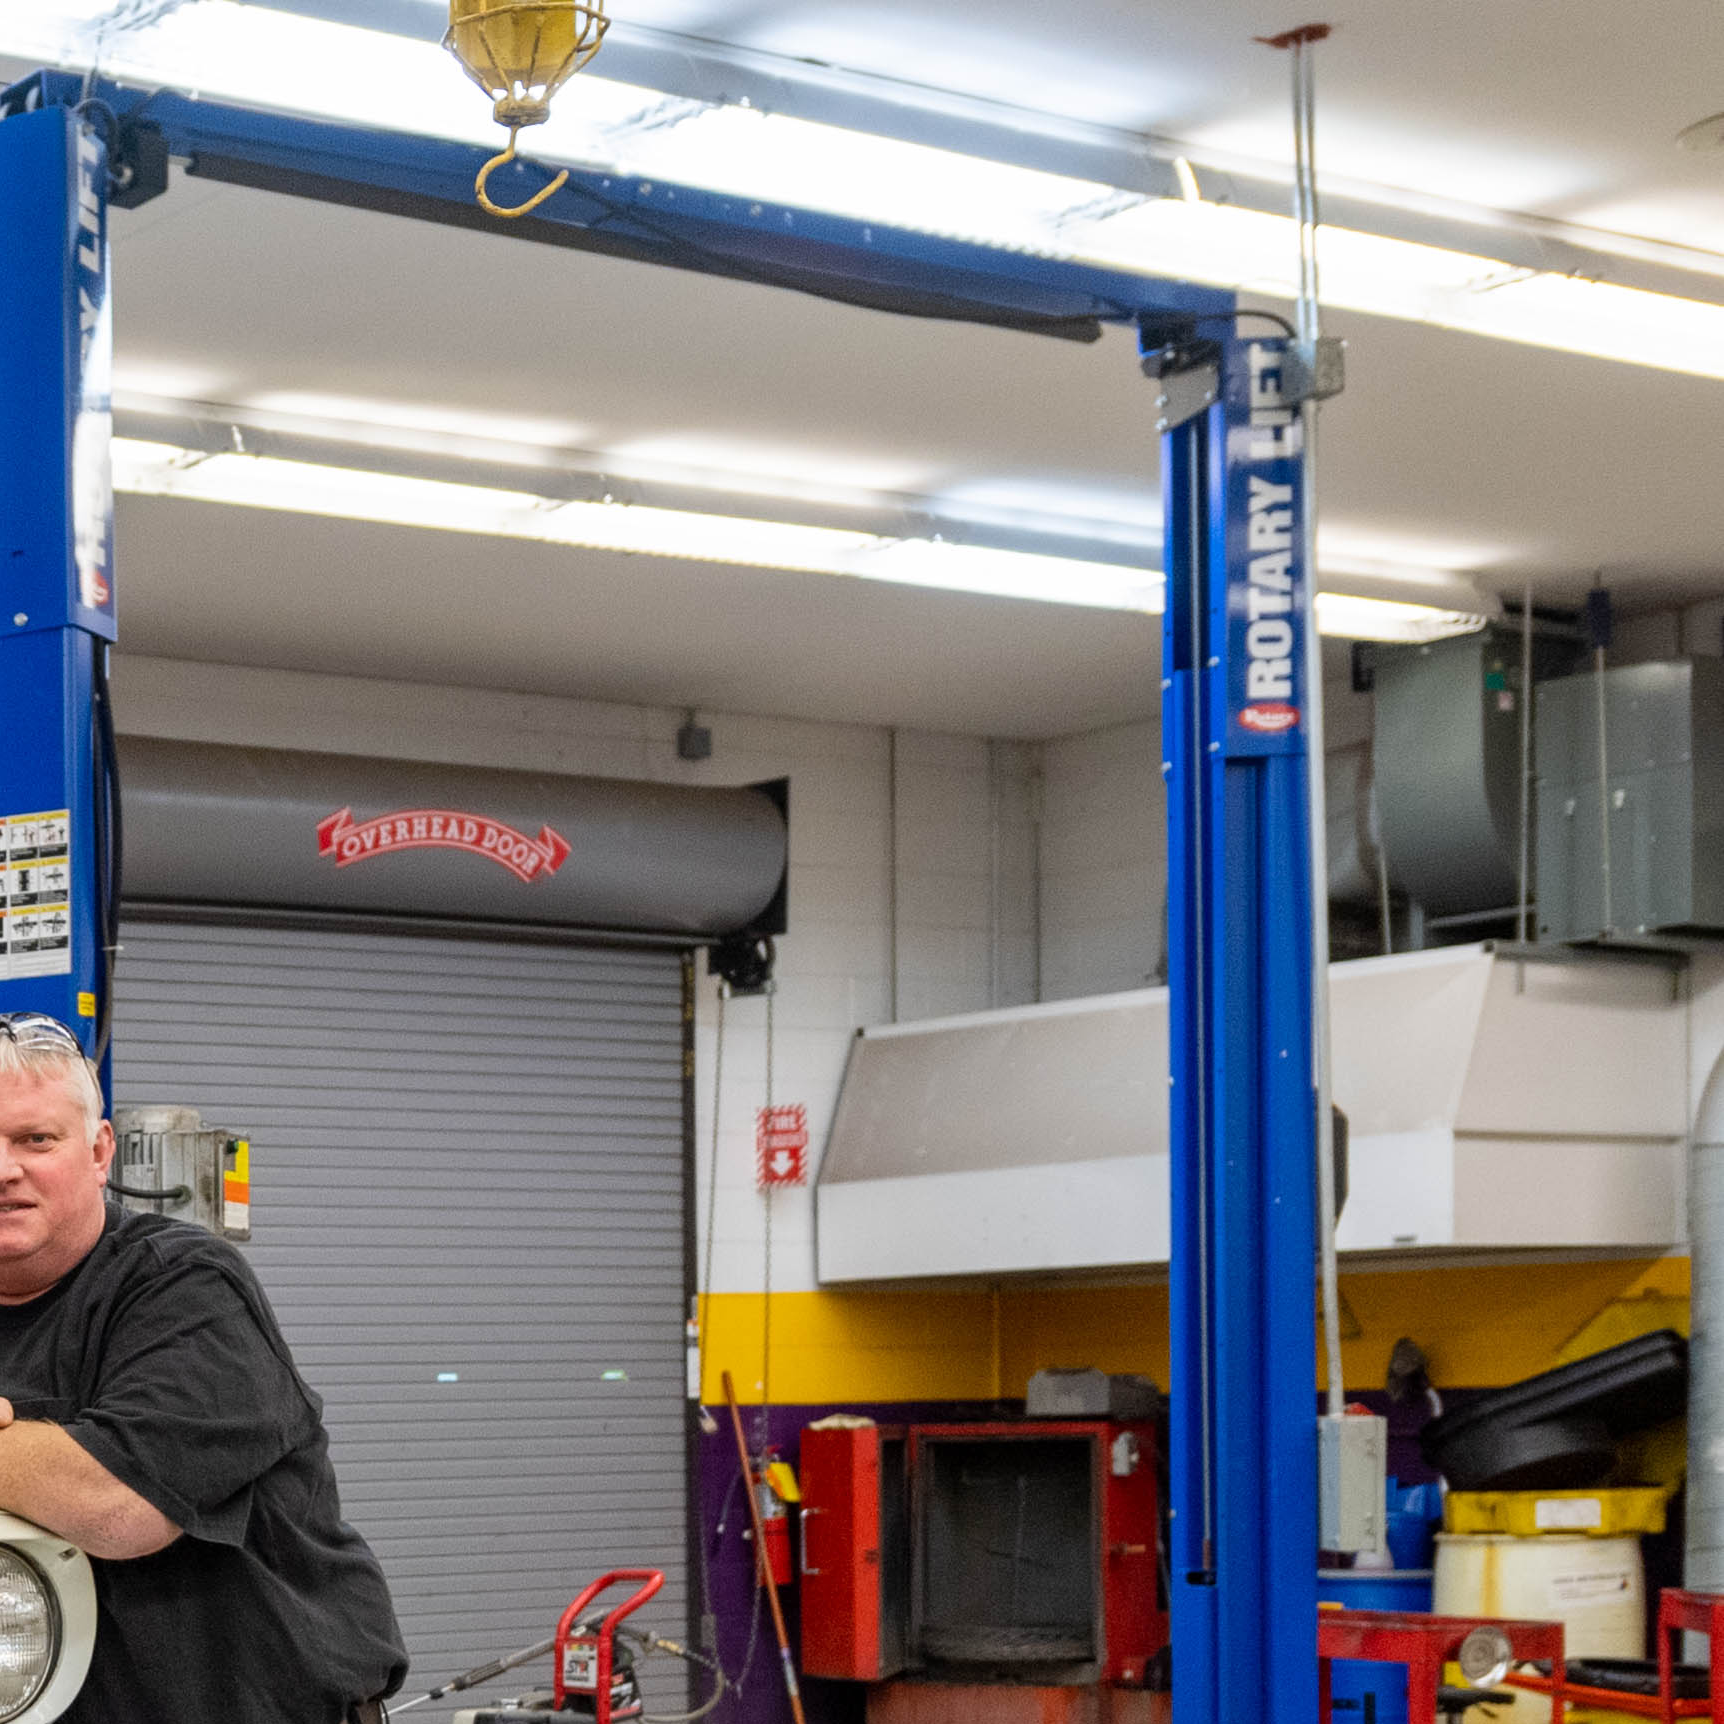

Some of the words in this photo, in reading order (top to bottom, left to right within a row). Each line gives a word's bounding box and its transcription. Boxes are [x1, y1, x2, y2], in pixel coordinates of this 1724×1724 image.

[75, 127, 105, 274] LIFT
[1249, 343, 1293, 458] LIFT
[1246, 476, 1295, 701] ROTARY
[341, 815, 478, 857] OVERHEAD
[483, 826, 542, 874] DOOR
